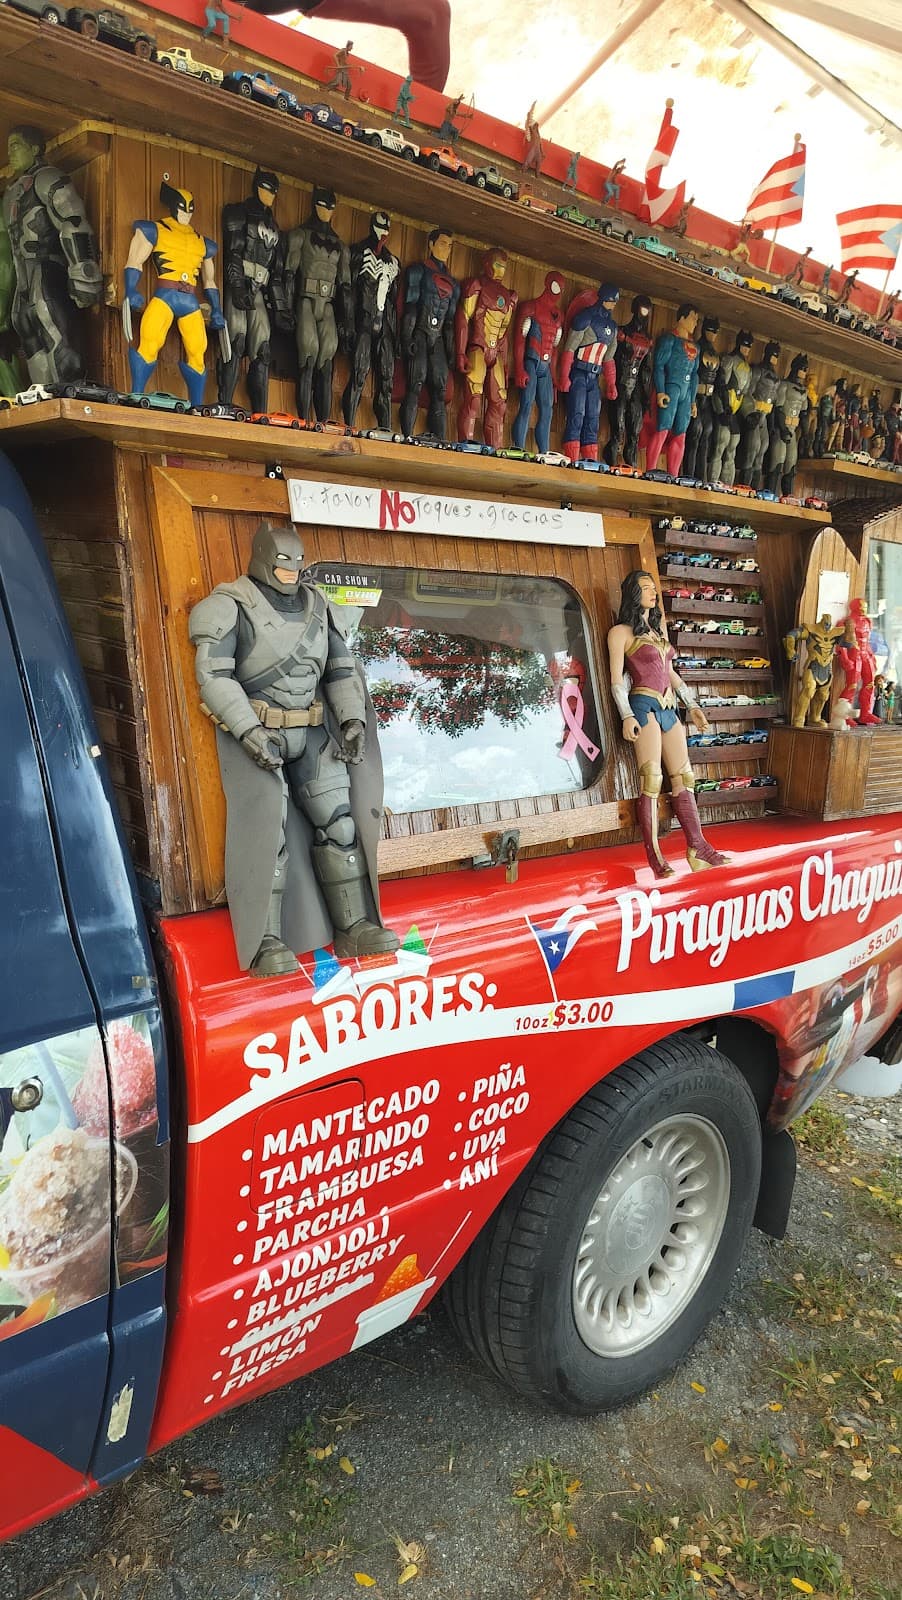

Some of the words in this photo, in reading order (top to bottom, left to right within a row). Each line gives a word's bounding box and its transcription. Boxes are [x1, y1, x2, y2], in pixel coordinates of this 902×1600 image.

[324, 573, 342, 585] CAR
[345, 575, 368, 586] SHOW
[616, 886, 794, 973] Piraguas
[867, 924, 899, 955] $5.00
[243, 972, 498, 1090] SABORES:
[515, 1017, 549, 1031] 10oz
[553, 1002, 614, 1030] $3.00
[468, 1092, 530, 1132] COCO
[472, 1062, 526, 1103] PIÑA
[261, 1079, 440, 1162] MANTECADO
[462, 1126, 506, 1160] UVA
[259, 1114, 430, 1195] TAMARINDO
[459, 1146, 499, 1190] ANÍ
[257, 1145, 425, 1232] FRAMBUESA
[252, 1197, 366, 1263] PARCHA
[252, 1206, 390, 1297] AJONJOLÍ
[246, 1234, 405, 1325] BLUEBERRY
[220, 1340, 306, 1398] FRESA
[229, 1314, 323, 1376] LIMÓN
